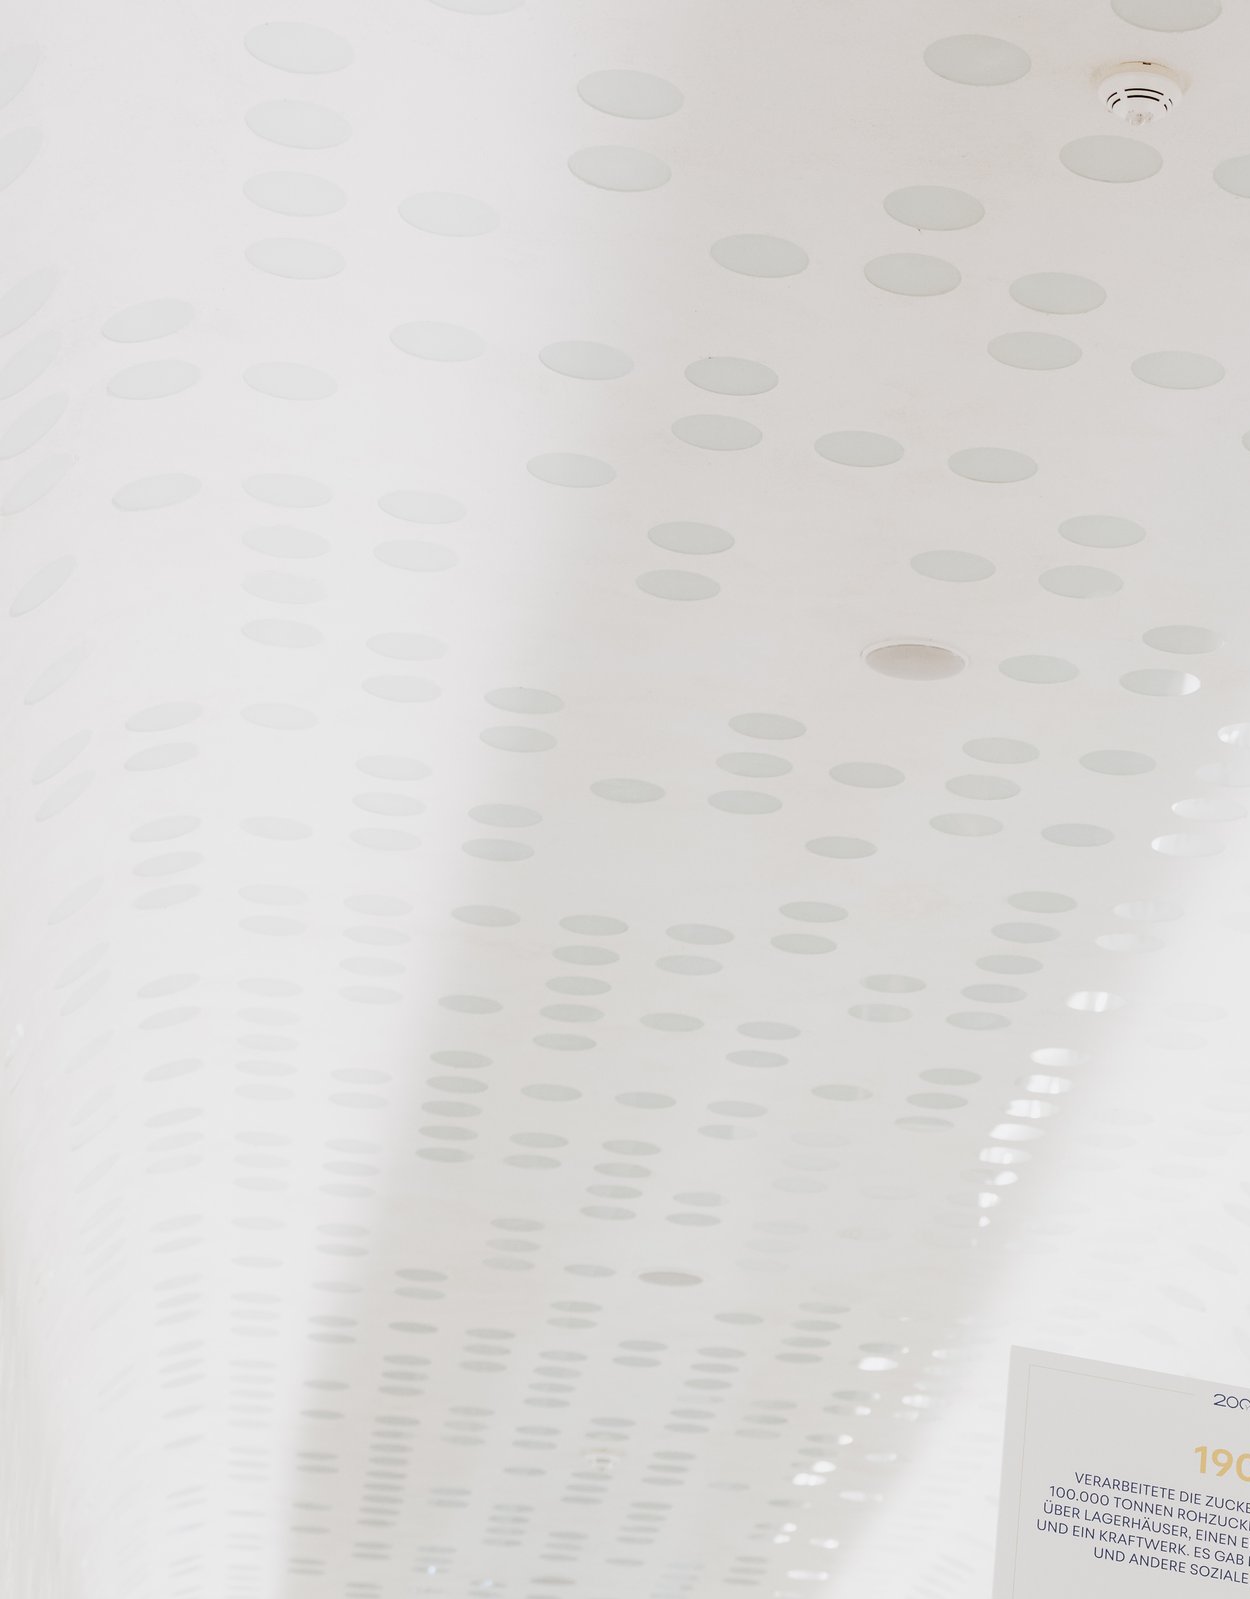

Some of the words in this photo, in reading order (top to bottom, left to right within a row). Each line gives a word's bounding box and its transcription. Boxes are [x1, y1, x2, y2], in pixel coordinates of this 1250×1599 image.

[1049, 1486, 1109, 1506] 100.000
[1114, 1497, 1173, 1517] TONNEN
[1075, 1472, 1175, 1500] VERARBEITETE
[1180, 1491, 1201, 1505] DIE
[1044, 1500, 1080, 1519] ÜBER
[1085, 1509, 1191, 1541] LAGERHÄUSER,
[1196, 1529, 1237, 1546] EINEN
[1037, 1519, 1068, 1534] UND
[1073, 1525, 1095, 1539] EIN
[1100, 1530, 1189, 1556] KRAFTWERK.
[1194, 1547, 1210, 1559] ES
[1215, 1551, 1244, 1565] GAB
[1094, 1547, 1125, 1562] UND
[1129, 1553, 1186, 1573] ANDERE
[1190, 1564, 1248, 1584] SOZIALE
